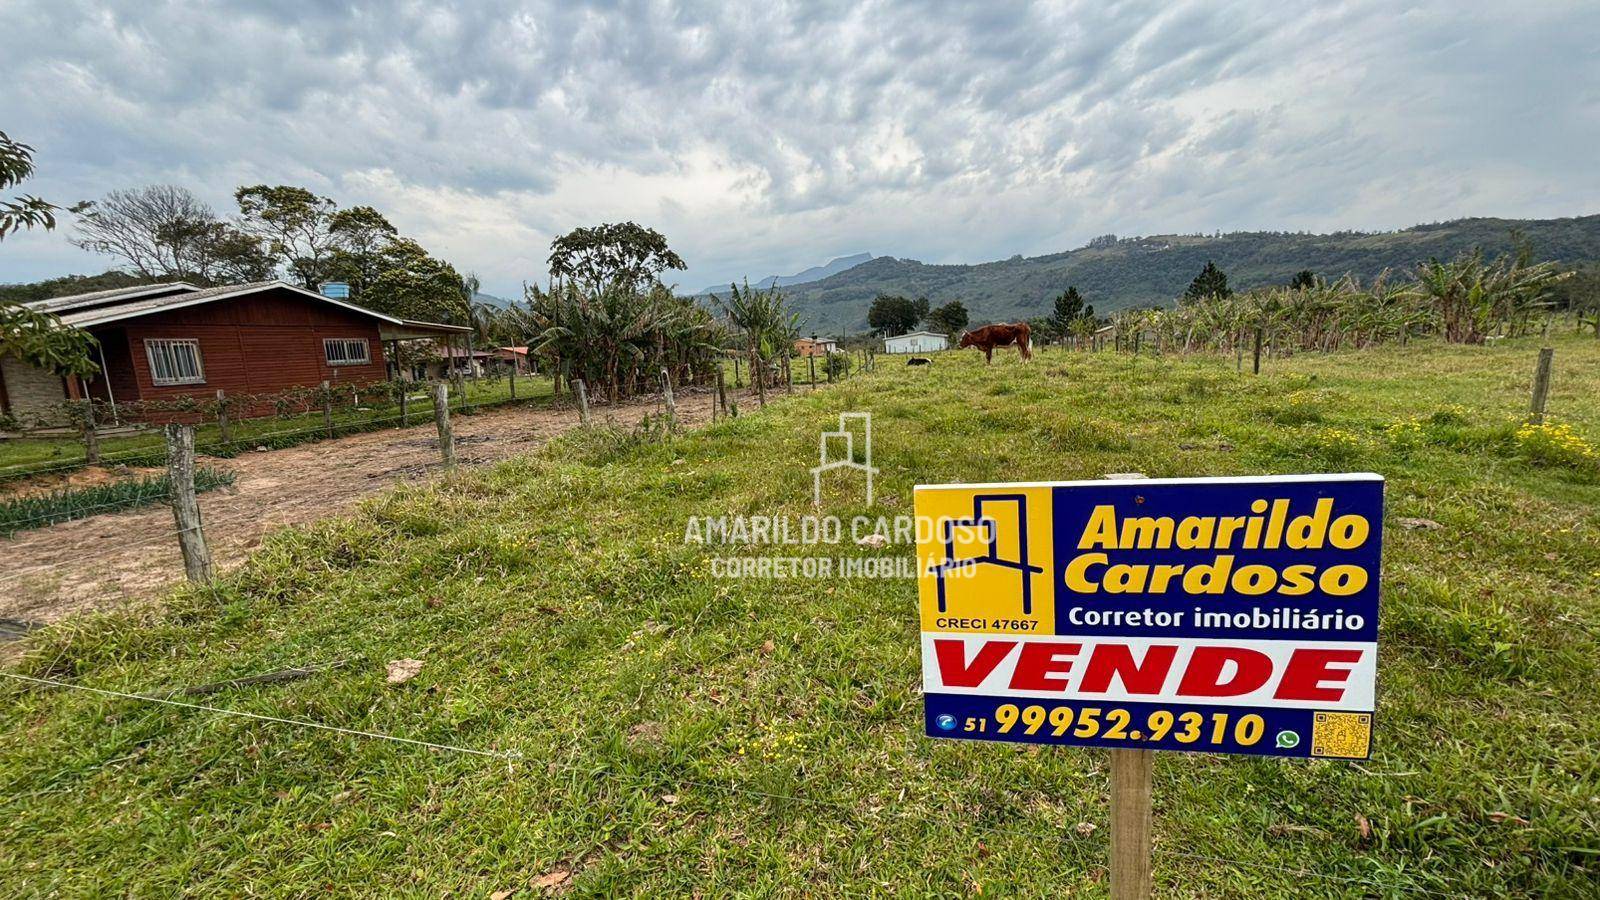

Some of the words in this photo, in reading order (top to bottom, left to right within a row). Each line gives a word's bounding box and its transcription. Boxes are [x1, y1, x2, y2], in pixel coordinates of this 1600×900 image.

[1077, 498, 1370, 550] Amarildo
[1064, 553, 1368, 596] Cardoso
[936, 617, 987, 629] CRECI
[991, 618, 1039, 631] 47667
[1068, 607, 1184, 628] Corretor
[1194, 607, 1365, 631] imobiliário
[934, 639, 1364, 702] VENDE
[963, 717, 987, 733] 51
[995, 704, 1265, 746] 99952.9310
